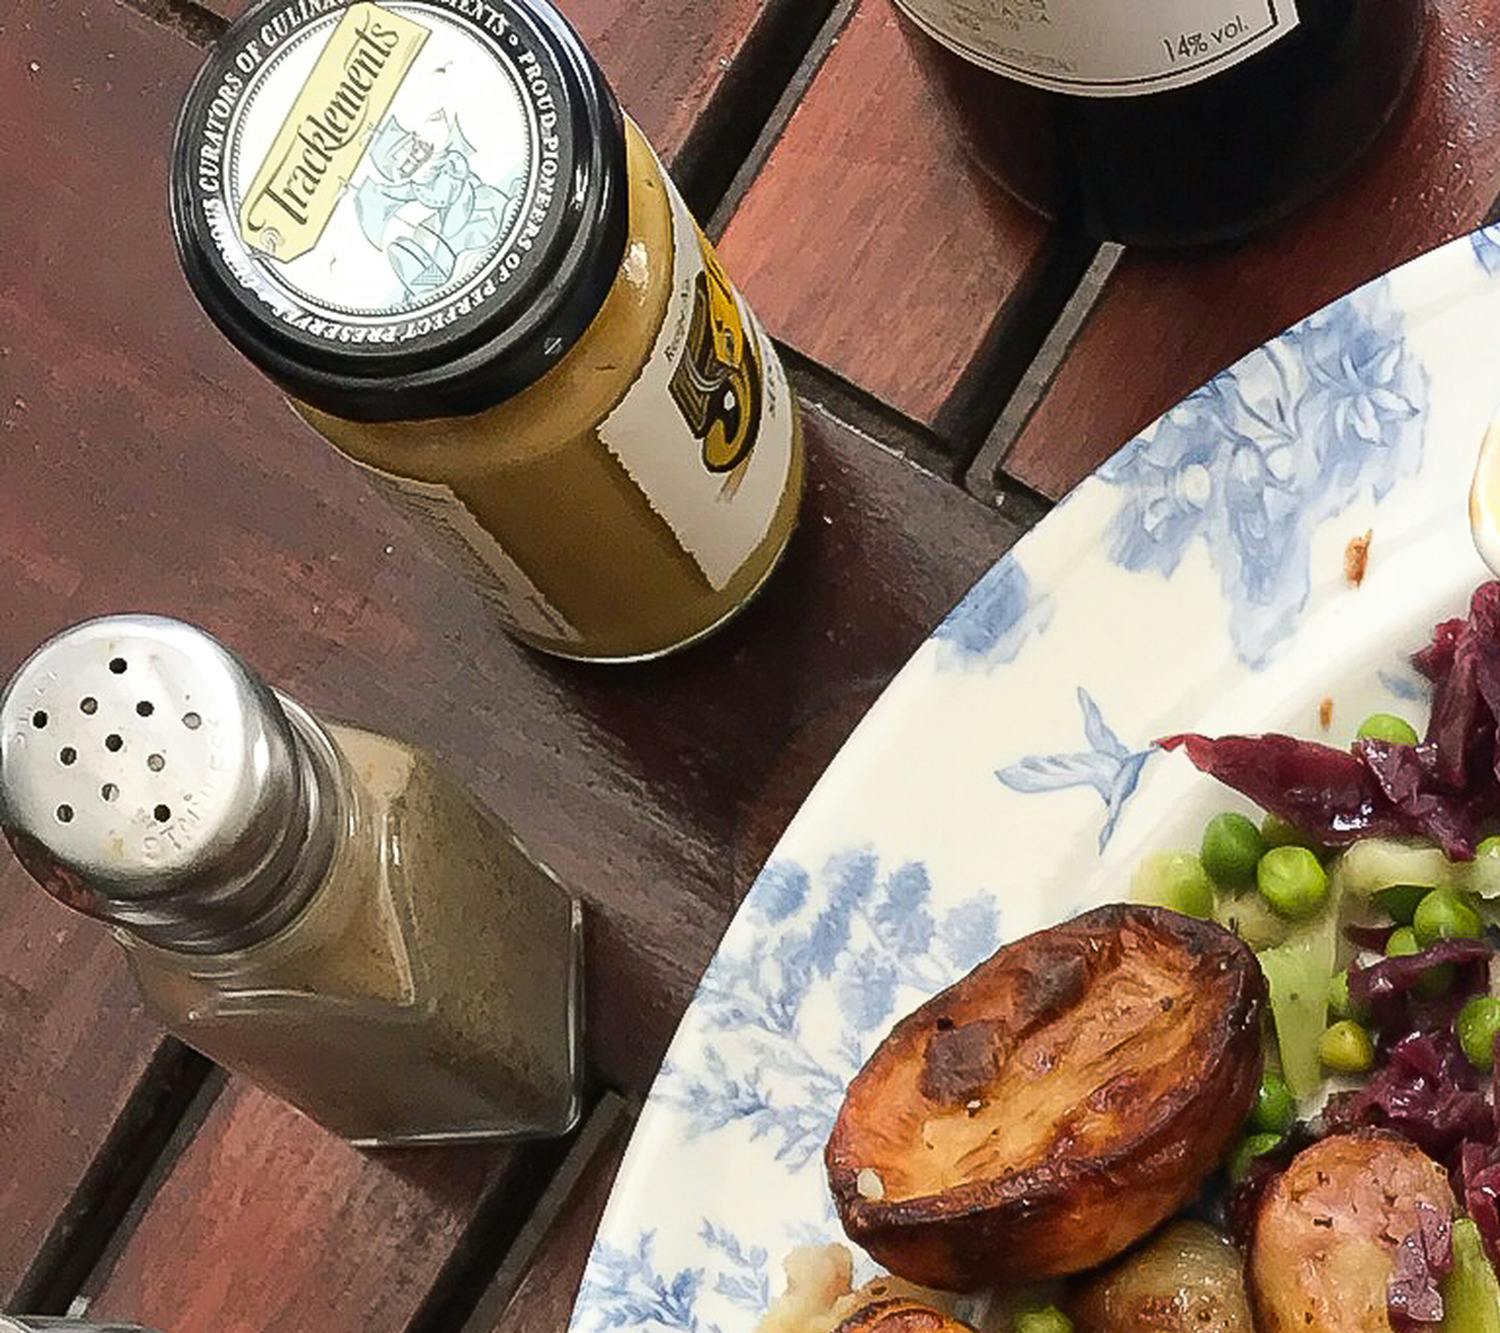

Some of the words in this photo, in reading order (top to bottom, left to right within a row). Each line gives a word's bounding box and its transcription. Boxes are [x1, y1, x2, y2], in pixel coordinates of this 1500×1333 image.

[235, 40, 264, 73] OF
[1163, 32, 1208, 62] 14%
[1210, 15, 1249, 43] vol.
[247, 10, 400, 232] Tracklements
[518, 50, 558, 126] PROUD
[199, 72, 244, 192] CURATORS
[517, 134, 561, 252] PIONEERS
[499, 253, 521, 283] OF
[399, 283, 497, 342] PERFECT
